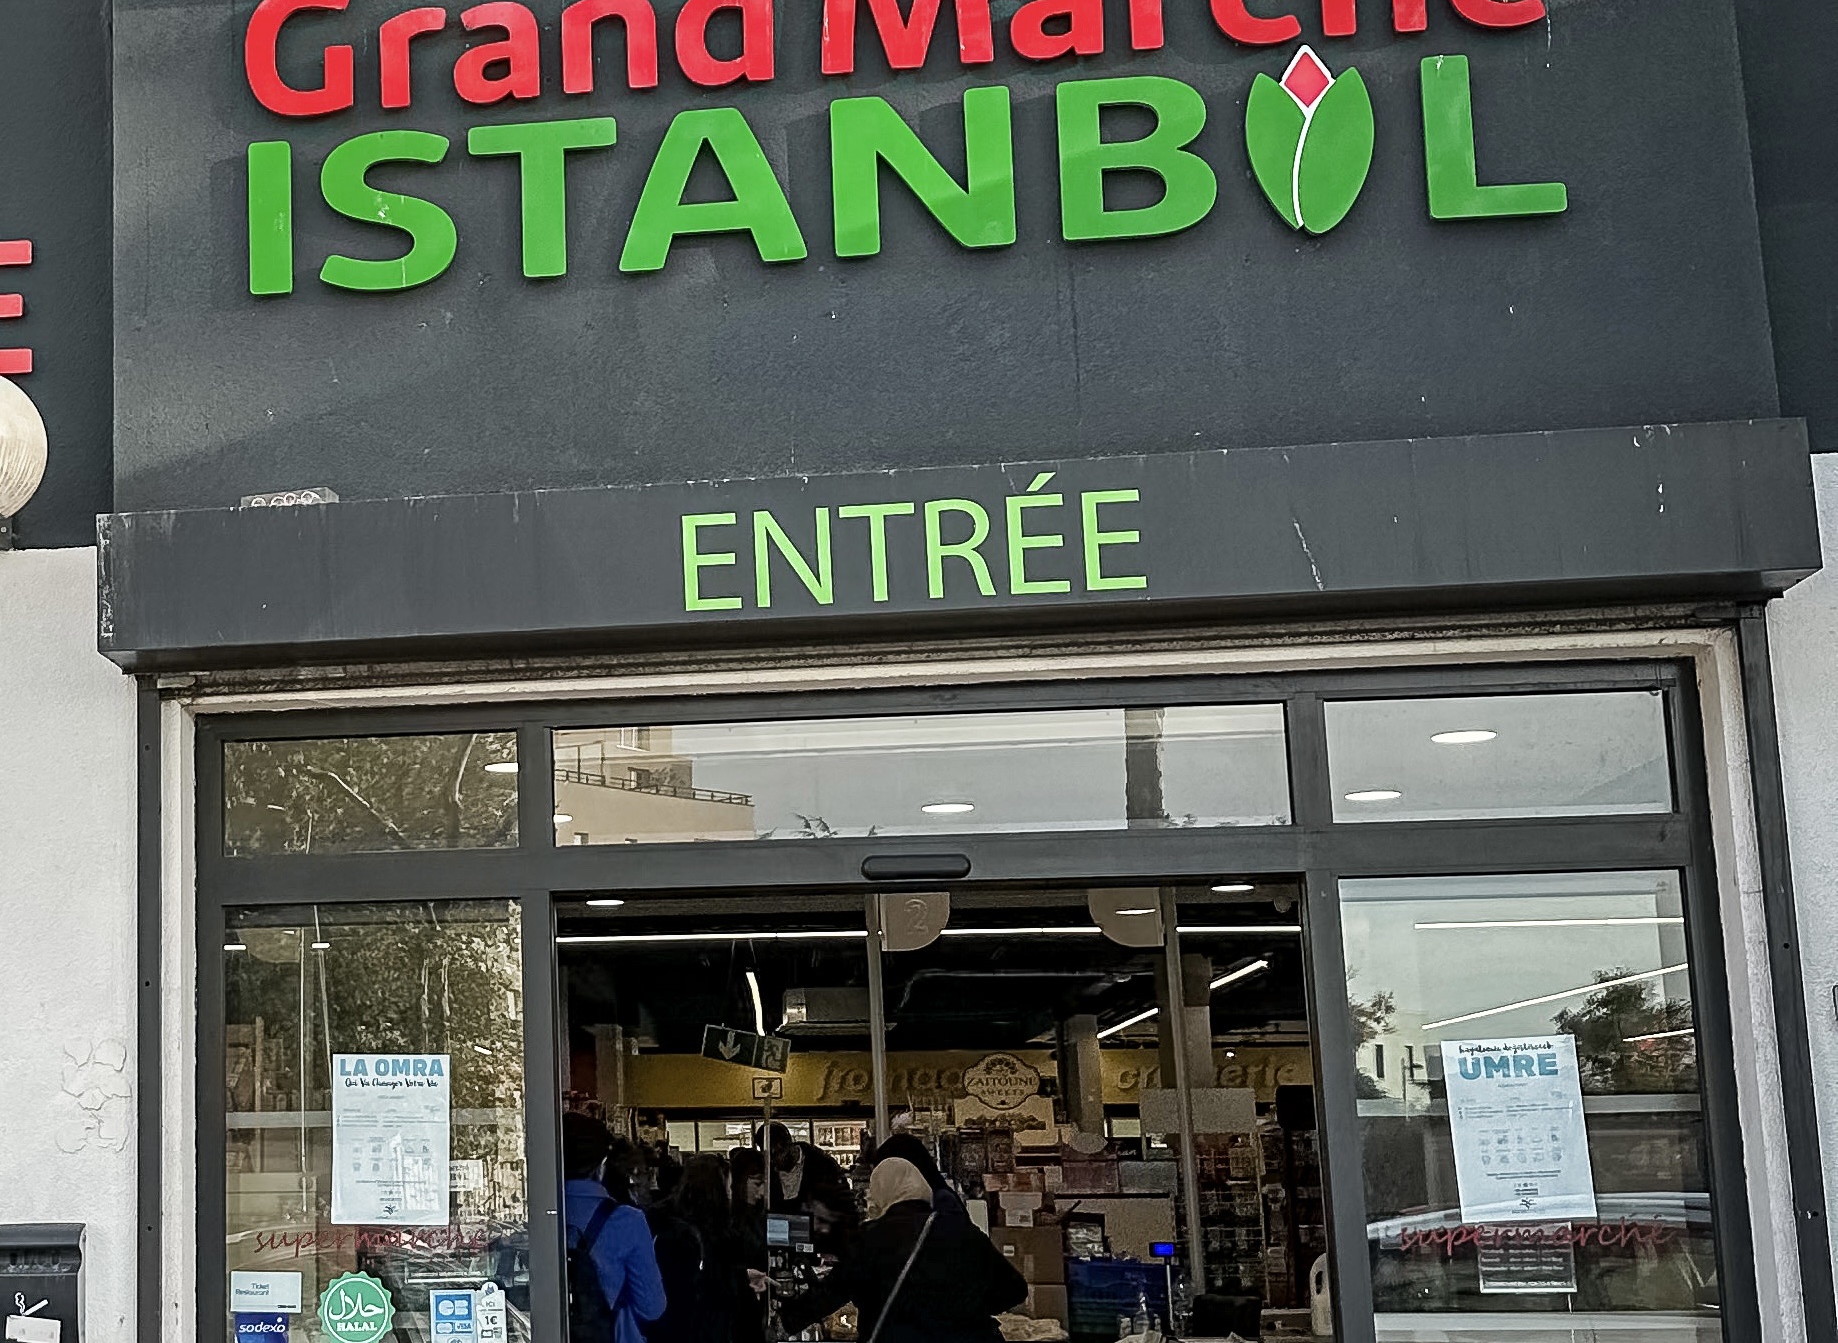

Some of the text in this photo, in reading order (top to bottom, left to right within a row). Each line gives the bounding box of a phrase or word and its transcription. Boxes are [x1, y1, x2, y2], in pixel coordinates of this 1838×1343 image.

[680, 472, 1148, 613] ENTRÉE
[904, 898, 928, 934] 2
[340, 1059, 444, 1076] LA OMRA
[1458, 1052, 1558, 1081] UMRE
[1399, 1214, 1675, 1256] supermarché
[328, 1289, 384, 1320] حلال
[239, 1321, 285, 1333] sodexo
[337, 1321, 377, 1332] HALAL
